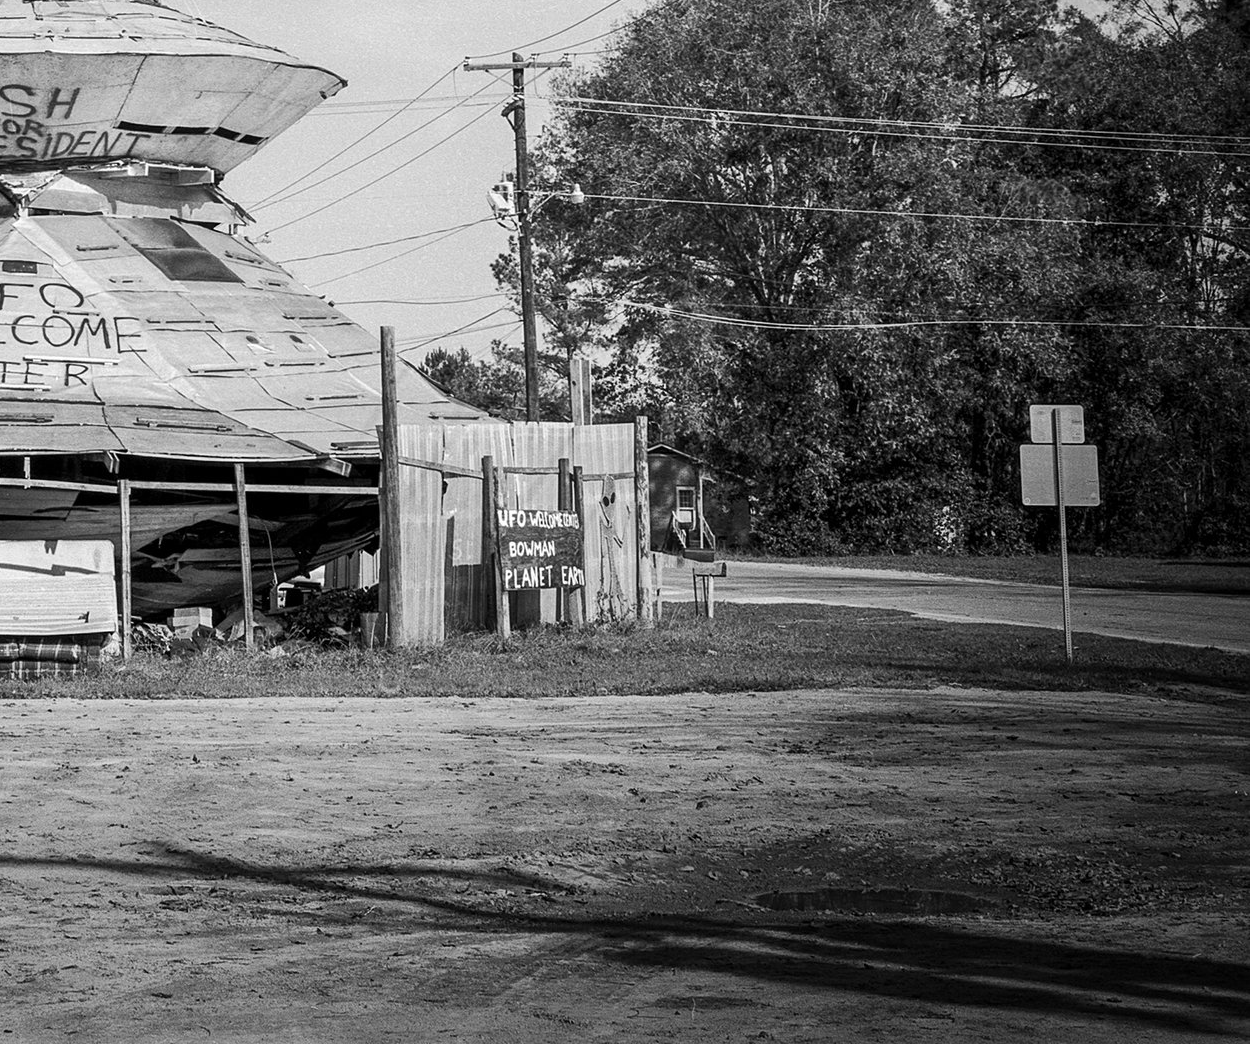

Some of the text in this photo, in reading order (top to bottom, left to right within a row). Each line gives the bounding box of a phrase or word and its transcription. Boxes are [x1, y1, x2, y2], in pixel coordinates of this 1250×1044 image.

[497, 509, 527, 528] UFO
[509, 540, 556, 557] BOWMAN
[505, 565, 553, 589] PLANET
